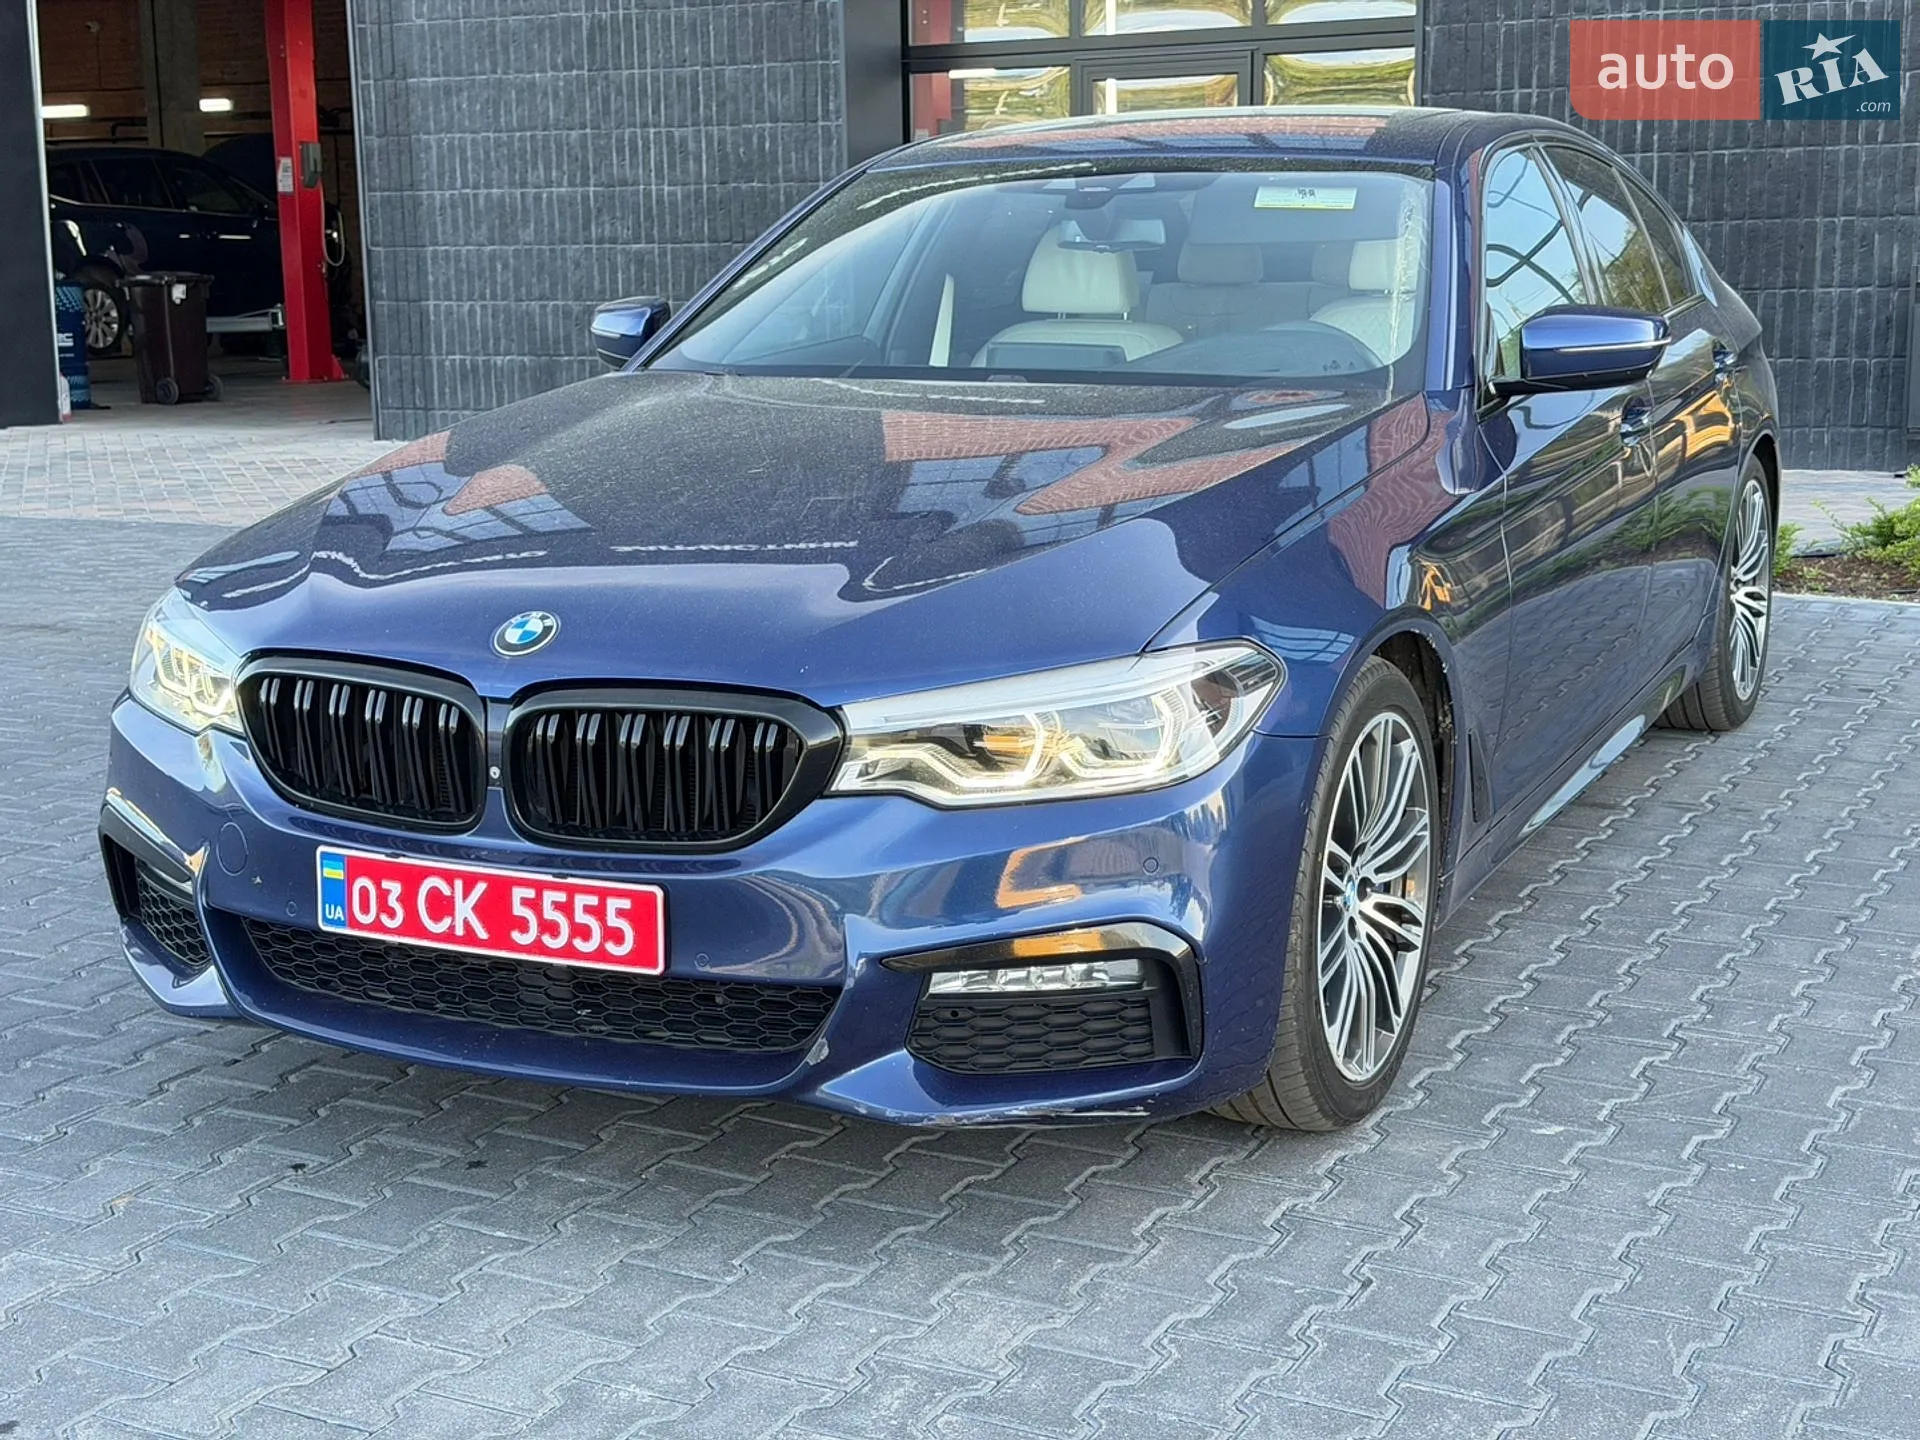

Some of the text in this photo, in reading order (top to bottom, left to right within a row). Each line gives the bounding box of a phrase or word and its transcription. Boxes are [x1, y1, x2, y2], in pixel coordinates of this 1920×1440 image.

[325, 903, 345, 921] UA
[352, 876, 635, 956] 03 CK 5555
